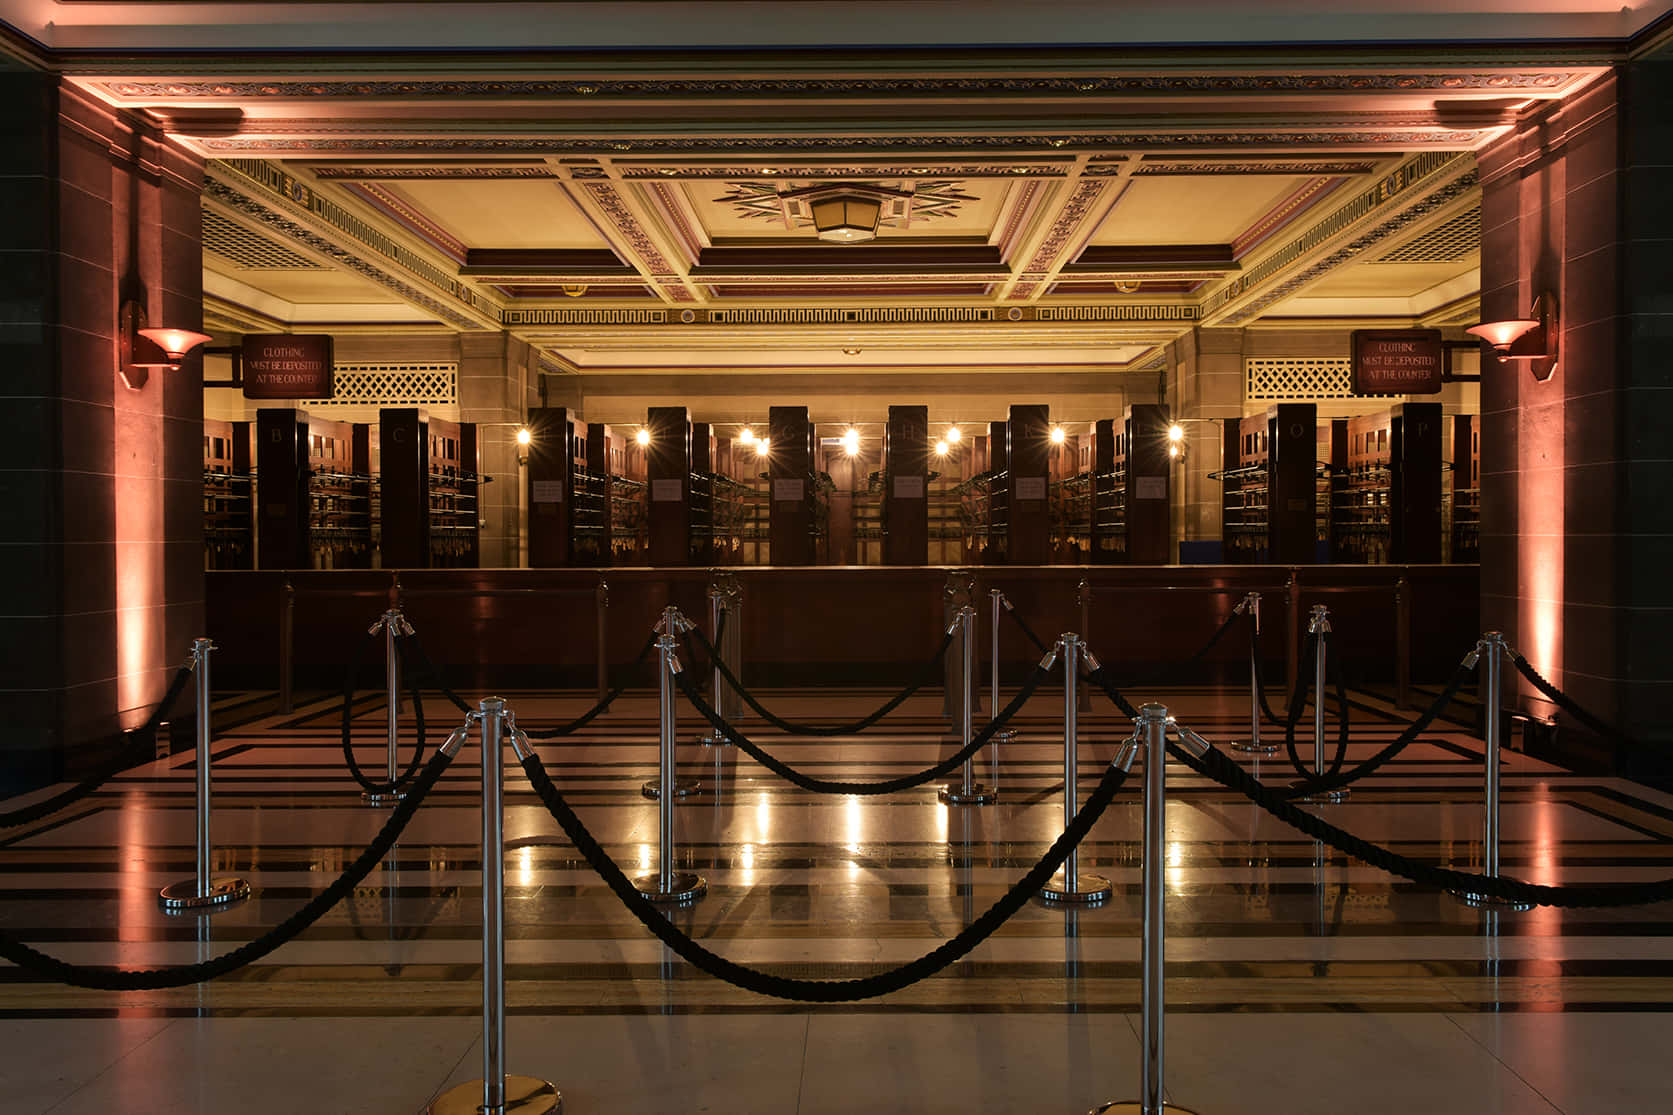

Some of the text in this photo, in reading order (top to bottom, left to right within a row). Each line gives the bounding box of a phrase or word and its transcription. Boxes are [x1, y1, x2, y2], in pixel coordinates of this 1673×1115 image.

[263, 347, 305, 357] CLOTHING
[1378, 343, 1417, 353] CLOTHING
[249, 360, 322, 370] MUST BE DEPOSITED
[1362, 355, 1436, 366] MUST BE DEPOSITED
[255, 373, 321, 384] AT THE COUNTER
[1367, 370, 1432, 380] AT THE COUNTER
[271, 427, 282, 442] B
[391, 426, 406, 442] C
